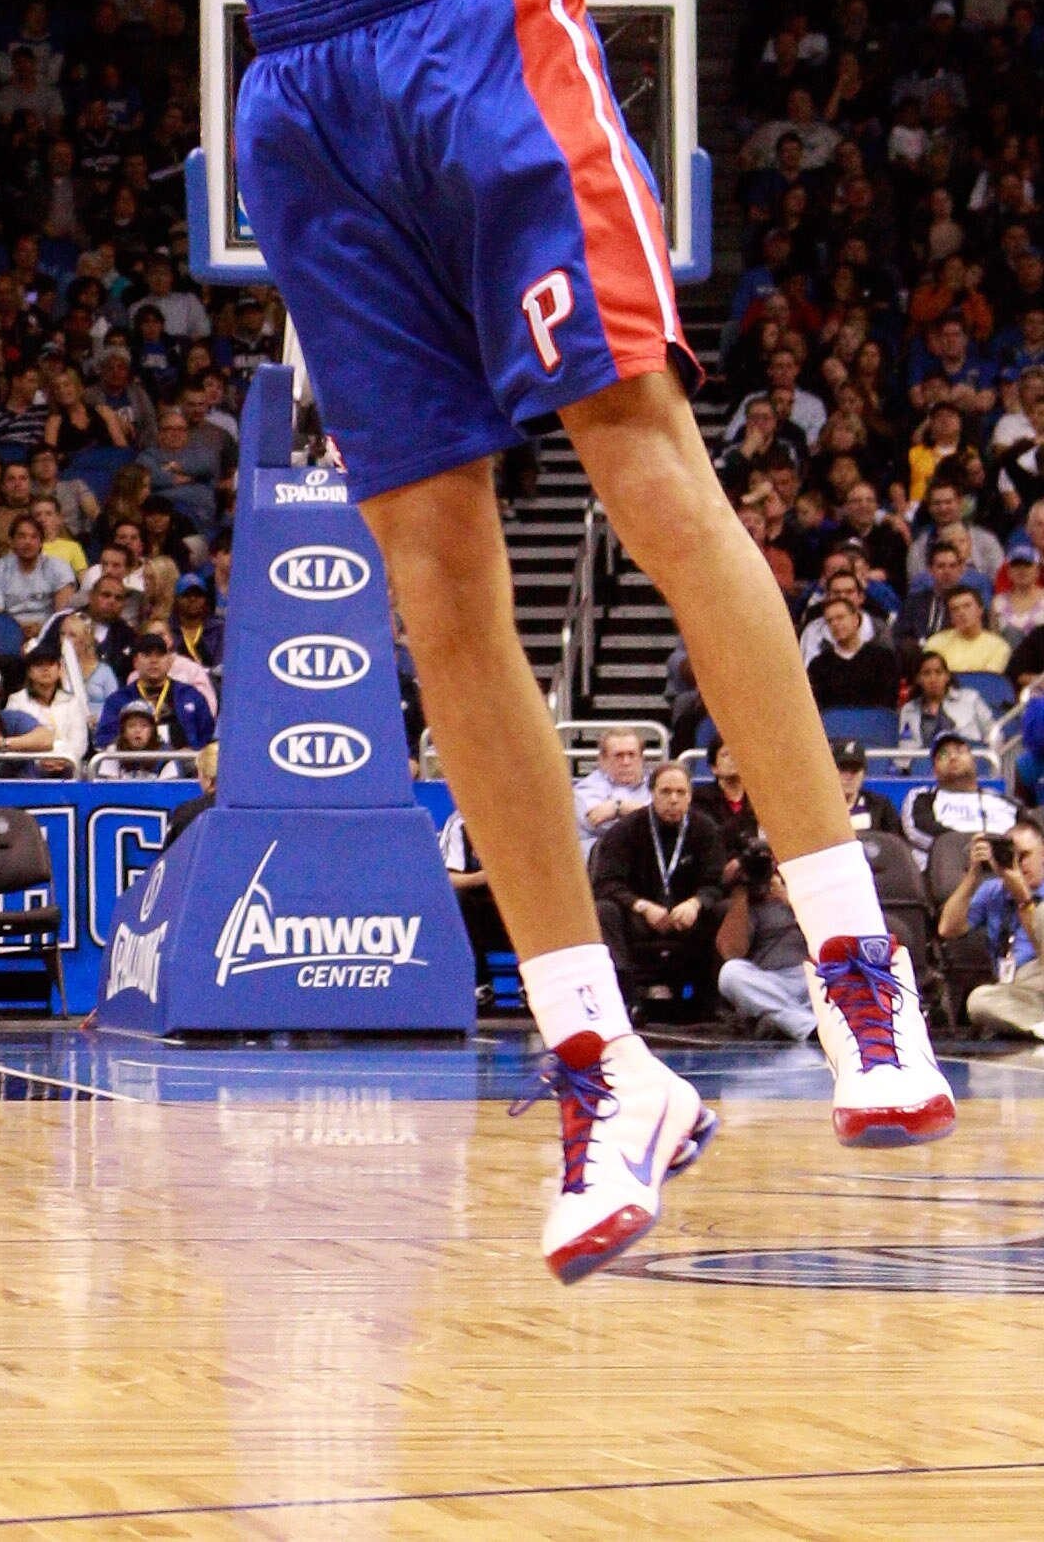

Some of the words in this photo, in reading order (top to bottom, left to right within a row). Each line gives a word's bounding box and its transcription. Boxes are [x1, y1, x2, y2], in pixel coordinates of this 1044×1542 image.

[521, 269, 574, 374] P
[275, 483, 348, 505] SPALDIN
[287, 559, 355, 587] KIA
[287, 648, 355, 676] KIA
[287, 735, 355, 764] KIA
[236, 902, 421, 965] Amway
[297, 964, 392, 988] CENTER
